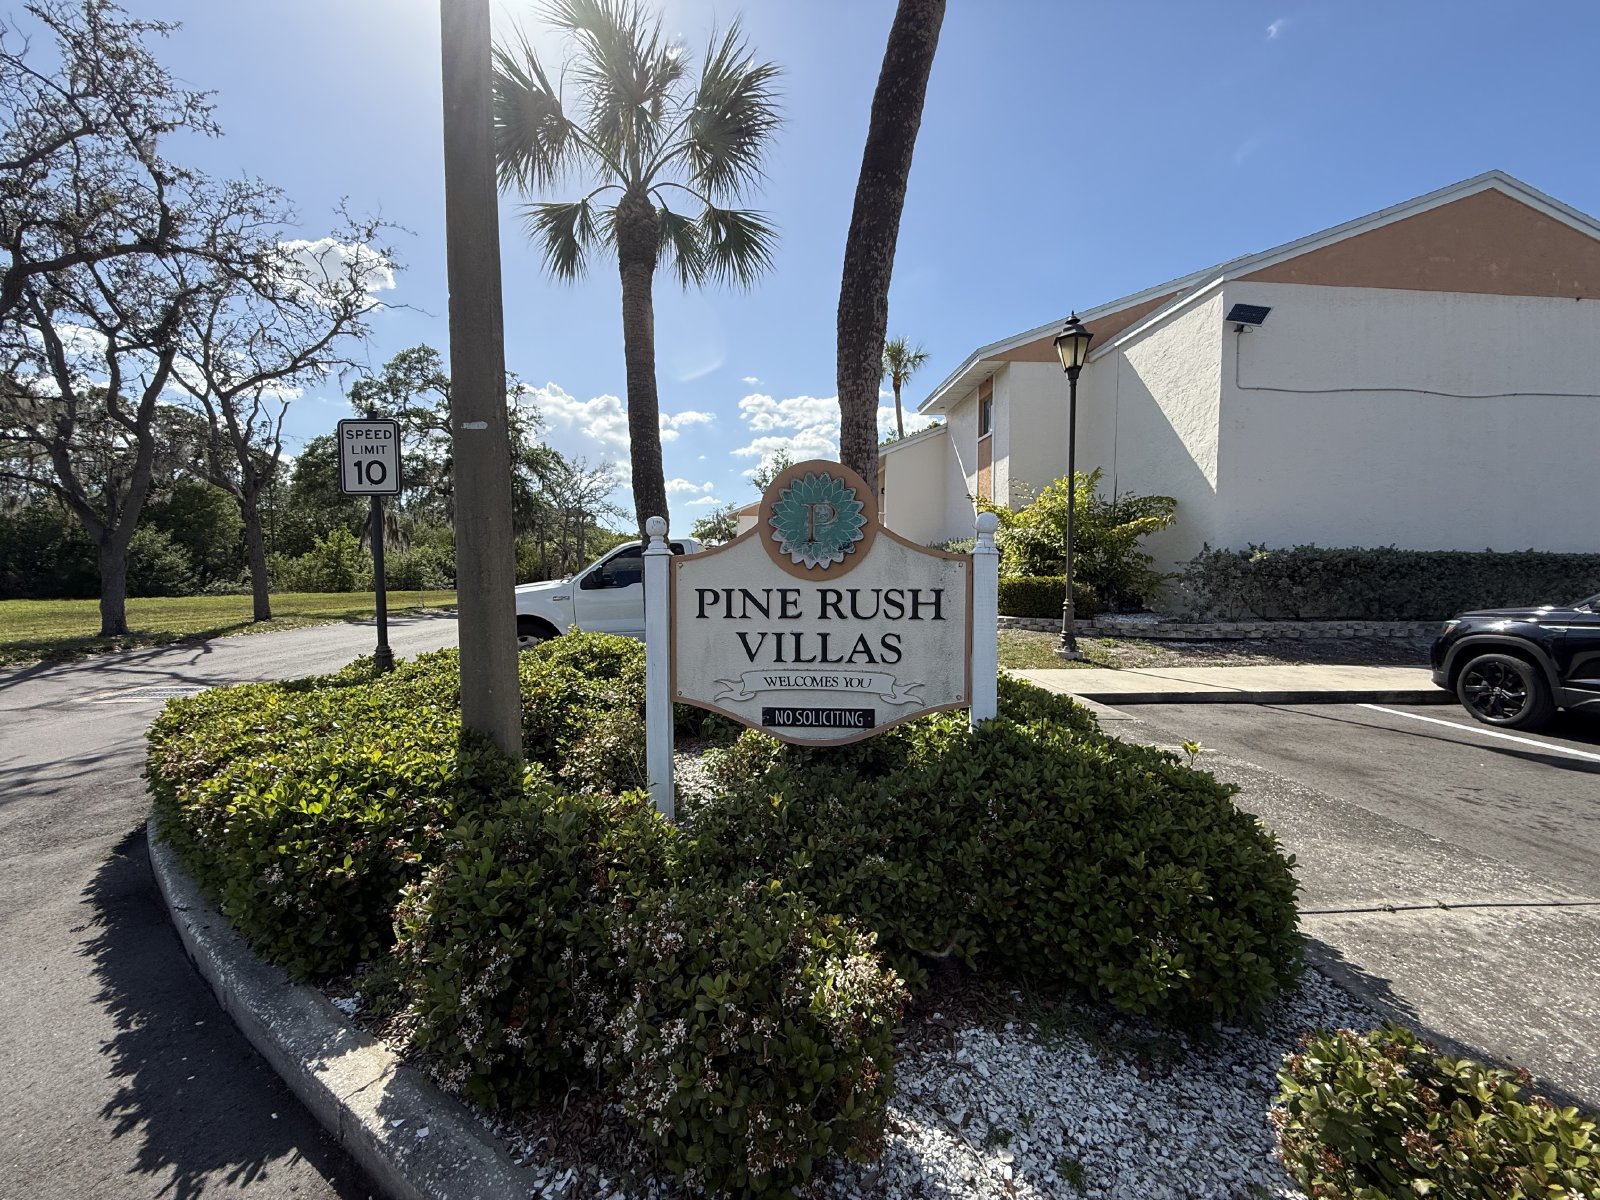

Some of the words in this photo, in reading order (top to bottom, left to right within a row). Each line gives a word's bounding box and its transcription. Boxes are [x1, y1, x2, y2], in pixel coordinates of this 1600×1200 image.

[345, 429, 392, 440] SPEED
[351, 445, 387, 455] LIMIT
[353, 460, 387, 485] 10
[800, 502, 838, 545] P
[694, 588, 803, 620] PINE
[816, 588, 946, 621] RUSH
[735, 631, 903, 664] VILLAS
[763, 675, 839, 688] WELCOMES
[843, 677, 872, 688] YOU
[775, 710, 793, 725] NO
[795, 710, 864, 726] SOLICITING
